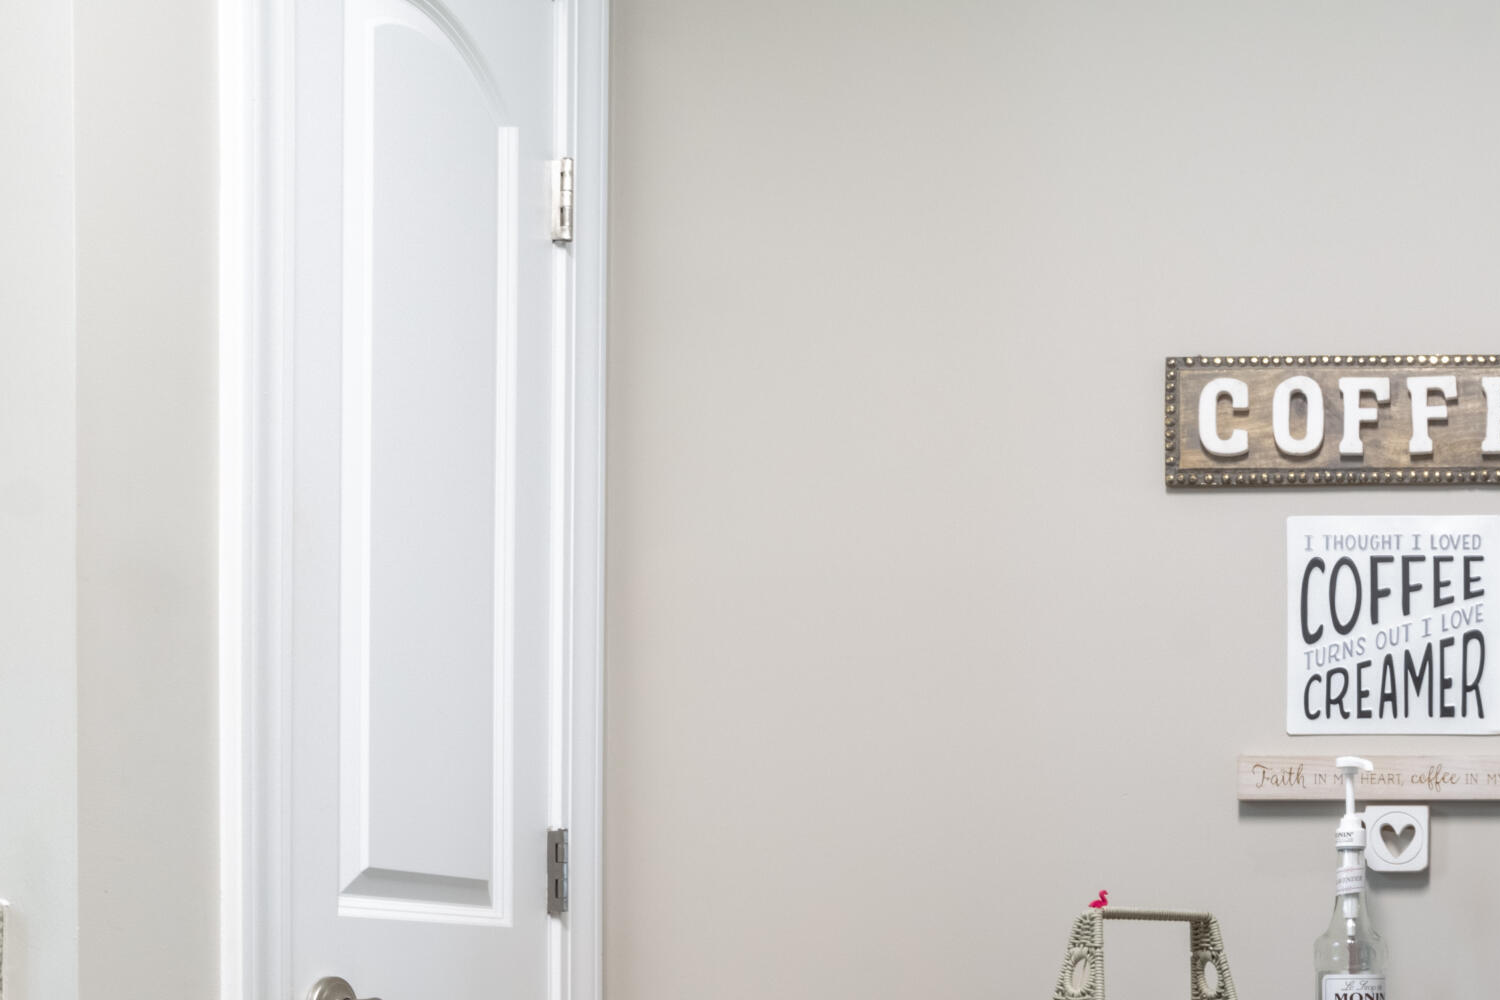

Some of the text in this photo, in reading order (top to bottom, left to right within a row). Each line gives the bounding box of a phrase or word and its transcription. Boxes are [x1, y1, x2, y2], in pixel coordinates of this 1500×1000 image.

[1304, 533, 1482, 550] I THOUGHT I LOVED
[1300, 555, 1485, 645] COFFEE
[1303, 603, 1484, 671] TURNS OUT I LOVE
[1303, 629, 1486, 721] CREAMER
[1252, 763, 1306, 789] Faith
[1314, 774, 1326, 785] IN
[1333, 774, 1344, 785] M
[1360, 773, 1404, 787] HEART,
[1410, 764, 1460, 792] coffee
[1465, 773, 1478, 785] IN
